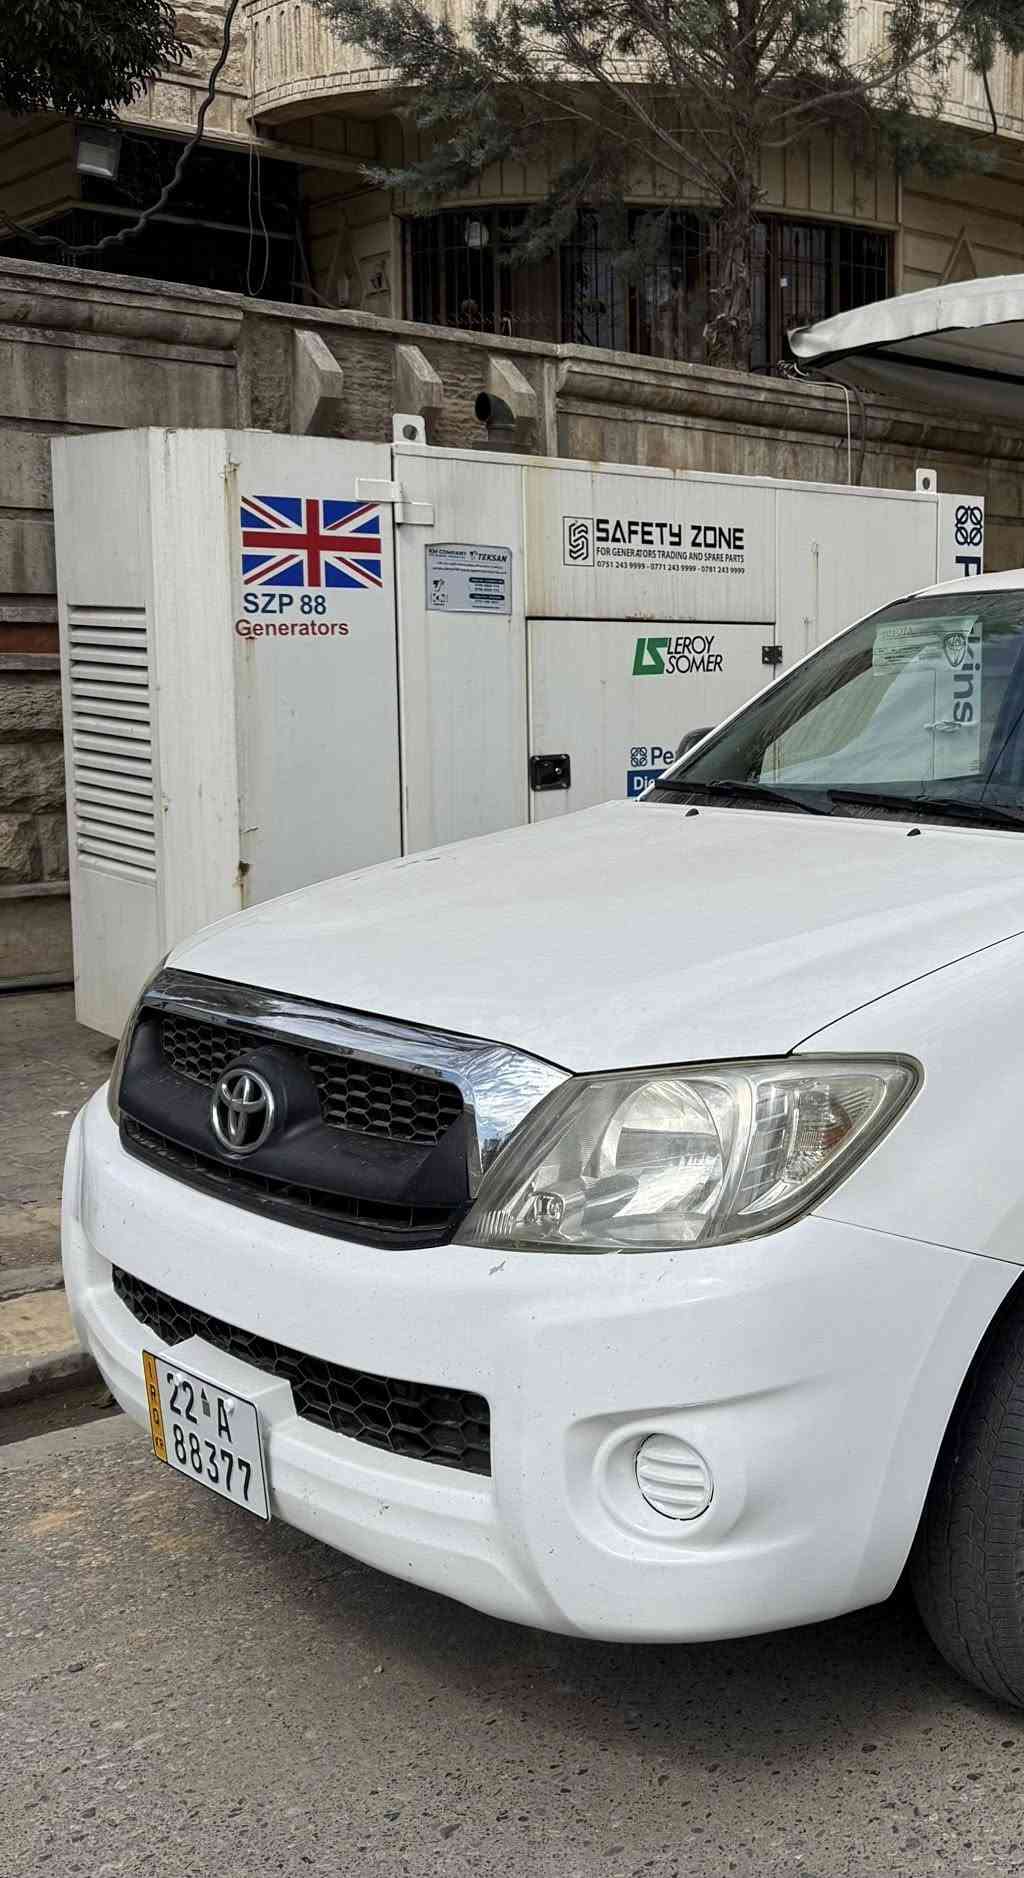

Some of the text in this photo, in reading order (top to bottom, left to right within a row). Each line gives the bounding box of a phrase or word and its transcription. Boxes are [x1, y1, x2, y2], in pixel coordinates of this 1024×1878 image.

[596, 518, 744, 550] SAFETY ZONE
[478, 552, 508, 563] TEKSAN
[596, 546, 744, 563] FOR GENERATORS TRADING AND SPARE PARTS
[243, 592, 327, 615] SZP 88
[235, 619, 350, 637] Generators
[666, 635, 715, 655] LEROY
[665, 654, 723, 674] SOMER
[167, 1373, 232, 1443] 22 A
[173, 1424, 251, 1501] 88377
